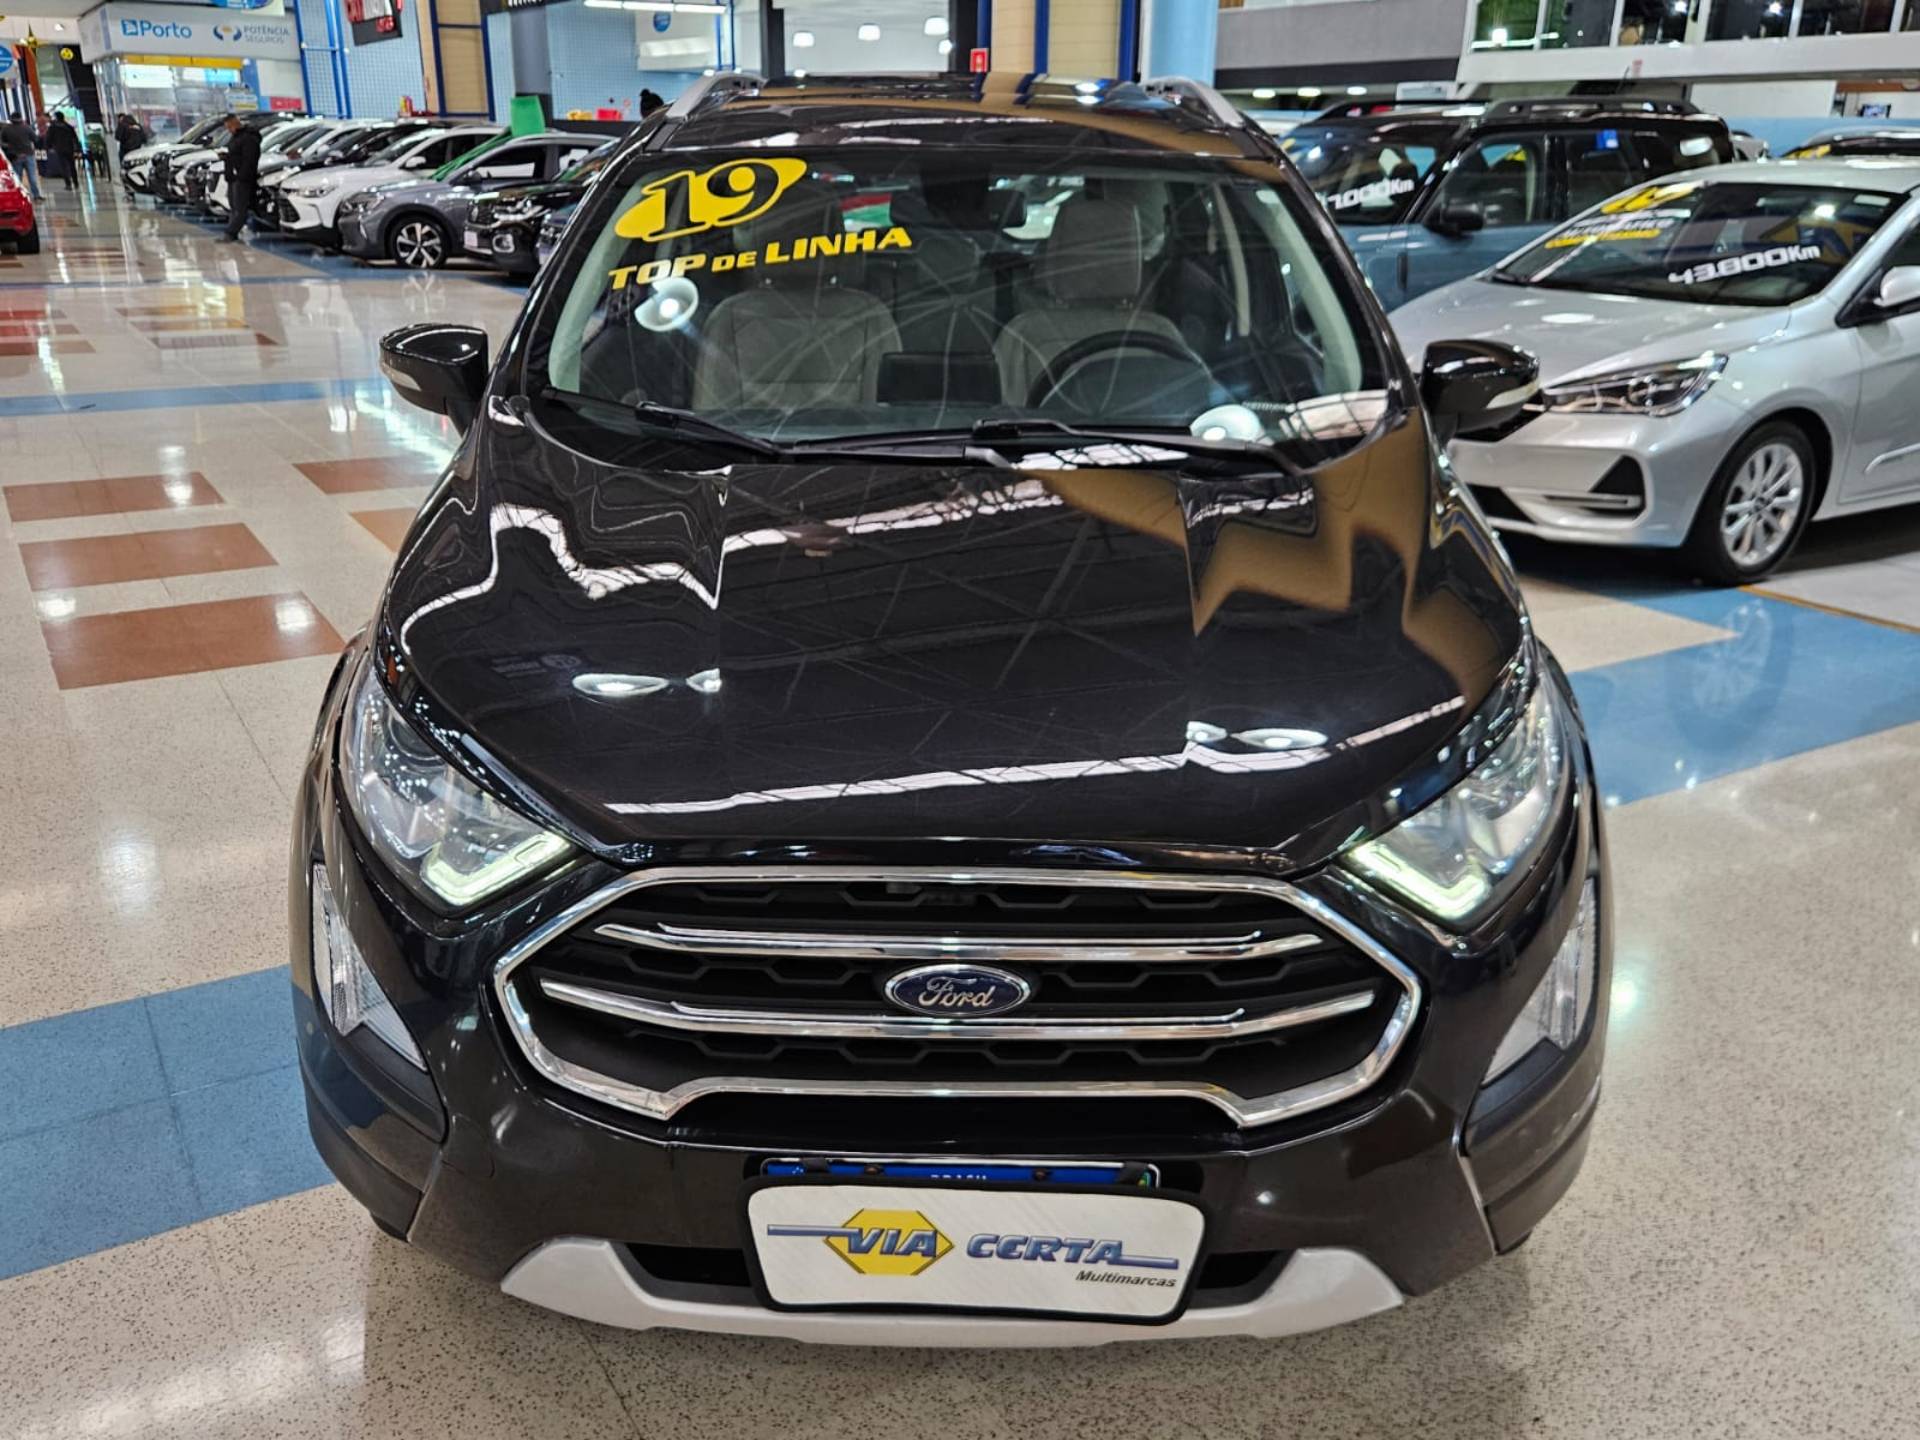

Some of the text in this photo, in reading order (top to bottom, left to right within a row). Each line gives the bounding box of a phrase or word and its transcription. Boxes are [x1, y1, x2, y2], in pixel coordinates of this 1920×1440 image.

[141, 20, 192, 39] Porto
[641, 160, 783, 241] 19
[608, 227, 912, 290] TOP DE LINHA
[918, 976, 996, 1007] Ford
[849, 1228, 938, 1258] VIA
[1075, 1270, 1176, 1288] Multimarcas
